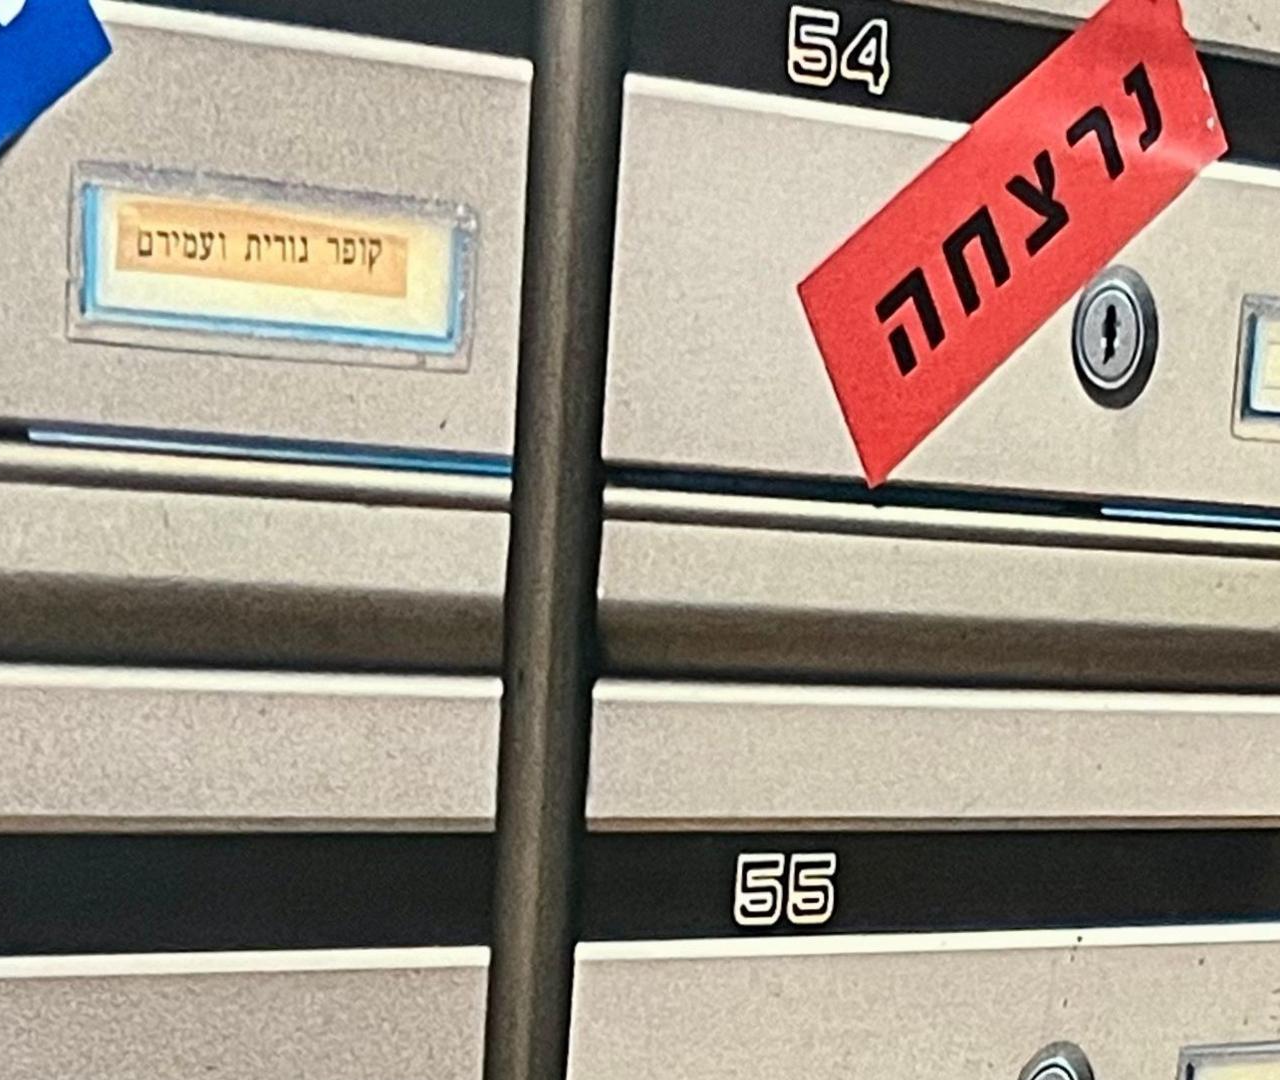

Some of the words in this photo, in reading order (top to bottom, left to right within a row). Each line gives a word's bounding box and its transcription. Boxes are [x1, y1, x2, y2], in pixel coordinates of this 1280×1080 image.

[788, 5, 890, 95] 54
[245, 232, 308, 263] נורית
[327, 236, 383, 274] קופר
[875, 63, 1165, 377] נרצחה
[733, 852, 837, 926] 55
